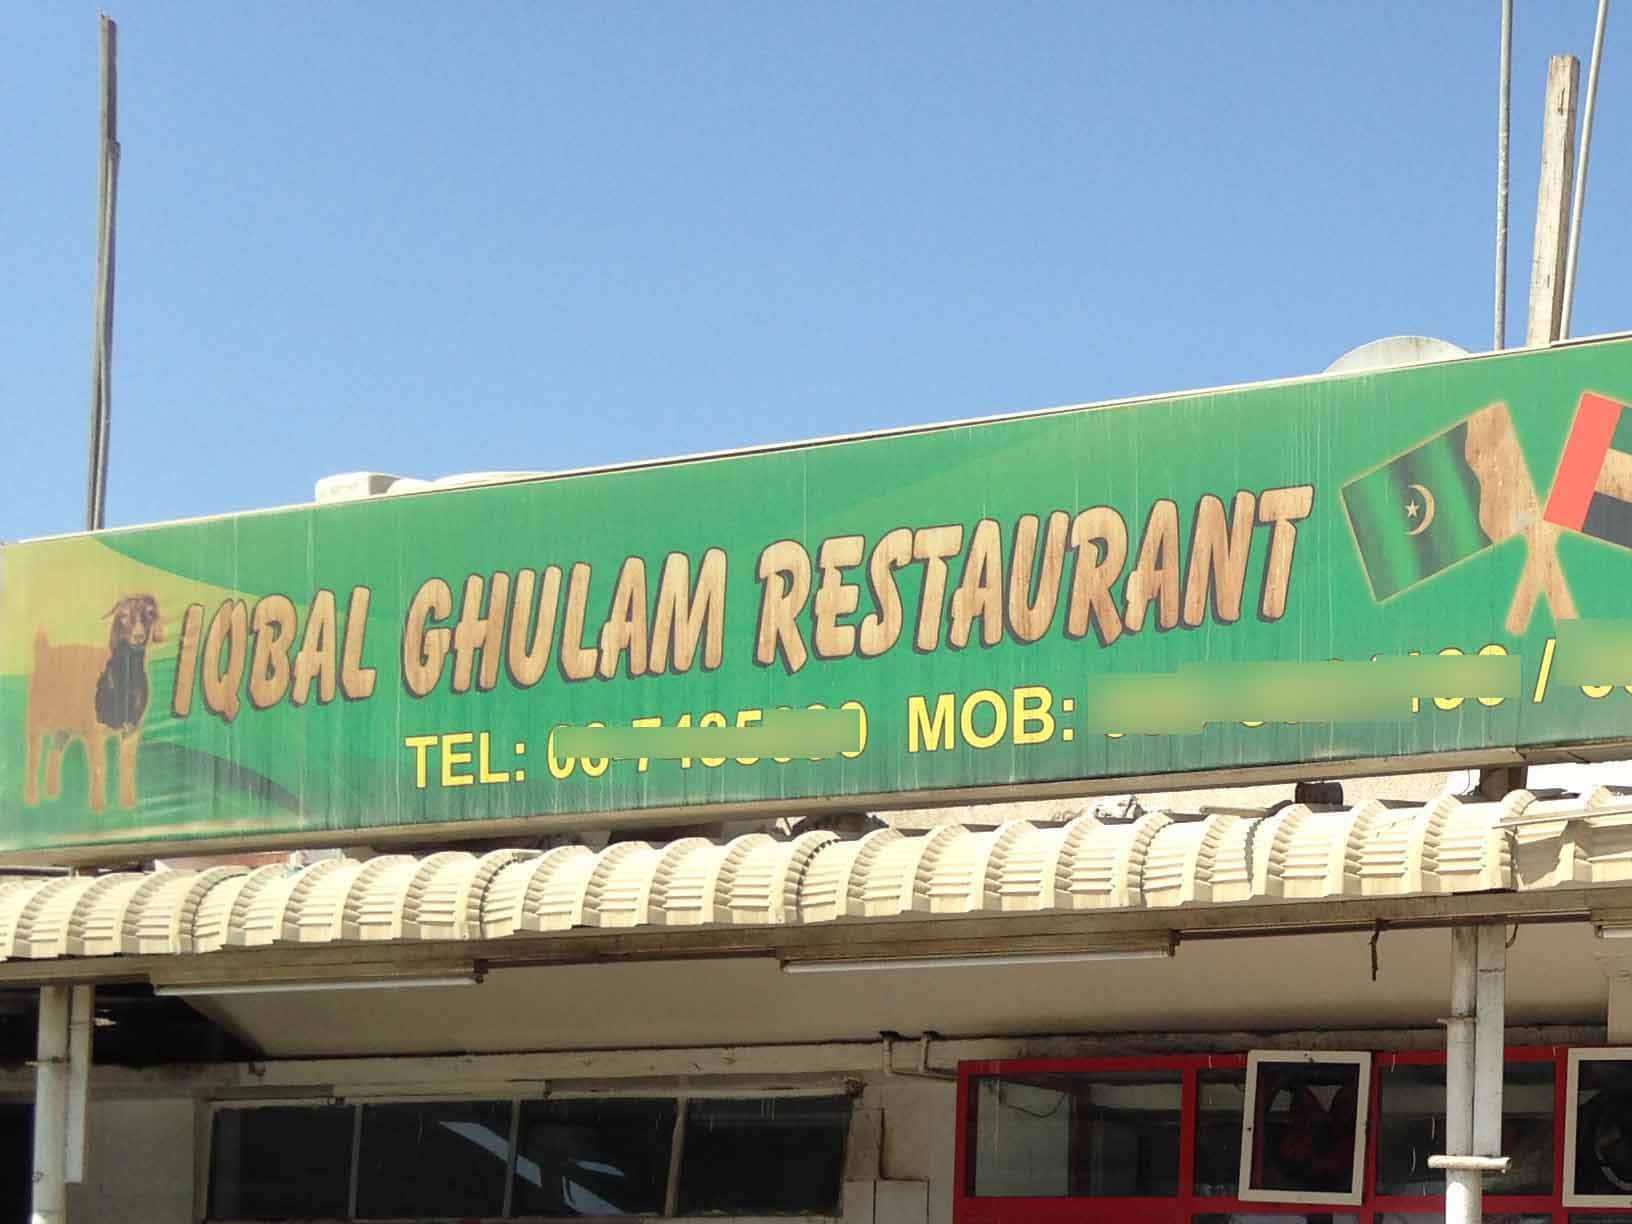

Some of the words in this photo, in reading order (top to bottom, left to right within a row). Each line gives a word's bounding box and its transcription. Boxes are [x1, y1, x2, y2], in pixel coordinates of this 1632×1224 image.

[171, 584, 377, 722] IQBAL
[403, 548, 727, 697] GHULAM
[755, 484, 1314, 673] RESTAURANT
[405, 734, 527, 789] TEL:
[907, 686, 1076, 753] MOB:
